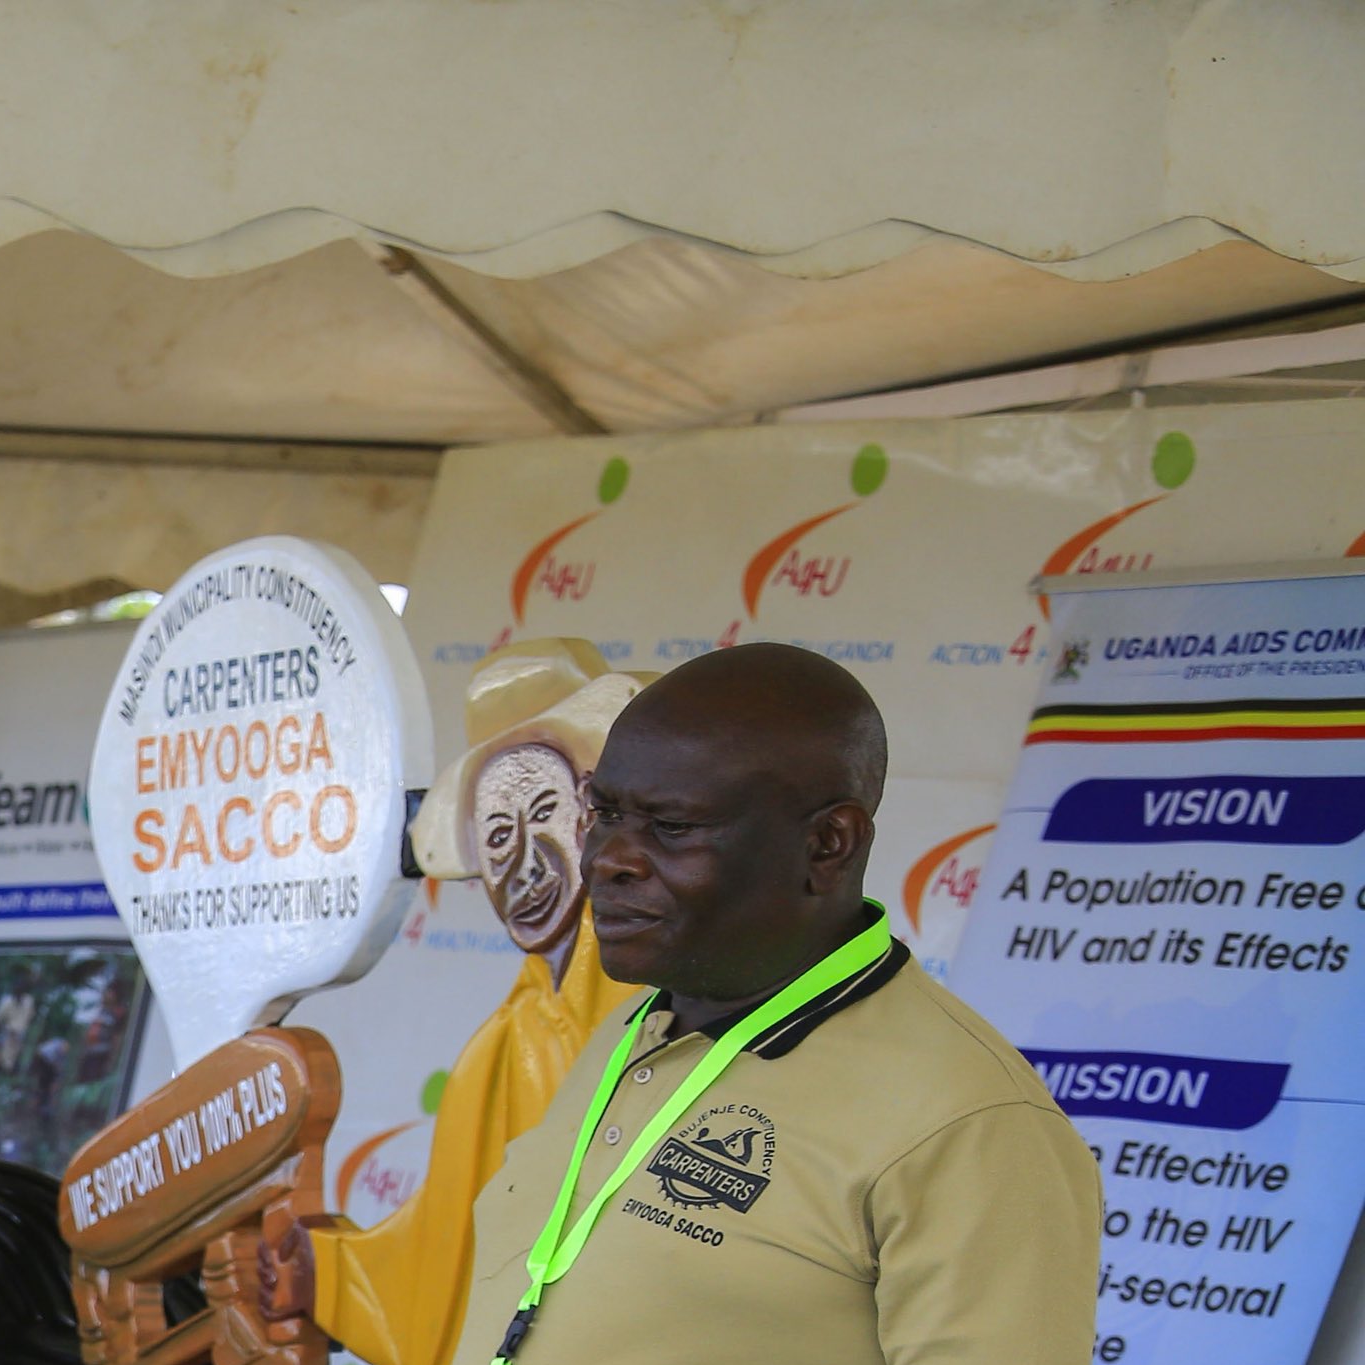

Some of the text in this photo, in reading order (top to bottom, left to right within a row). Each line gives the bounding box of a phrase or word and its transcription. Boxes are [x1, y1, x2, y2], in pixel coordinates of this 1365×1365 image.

[1009, 624, 1037, 664] 4
[1104, 636, 1217, 661] UGANDA
[1222, 630, 1287, 657] AIDS
[163, 644, 320, 718] CARPENTERS
[1184, 663, 1235, 679] OFFICE
[1237, 662, 1257, 678] OF
[1258, 660, 1287, 677] THE
[135, 711, 334, 795] EMYOOGA
[132, 784, 359, 874] SACCO
[1143, 788, 1289, 828] VISION
[133, 887, 192, 936] THANKS
[195, 886, 227, 931] FOR
[229, 878, 331, 928] SUPPORTING
[336, 875, 359, 918] US
[1002, 868, 1029, 901] A
[1042, 868, 1245, 913] Population
[1255, 872, 1343, 912] Free
[1007, 926, 1350, 974] HIV and its Effects
[678, 1104, 736, 1138] BUJENJE
[69, 1174, 98, 1233] WE
[92, 1133, 165, 1218] SUPPORT
[163, 1111, 202, 1176] YOU
[237, 1061, 287, 1133] PLUS
[1112, 1140, 1291, 1193] Effective
[657, 1147, 756, 1202] CARPENTERS
[621, 1198, 725, 1248] EMYOOGA SACCO
[1141, 1206, 1208, 1249] the
[1217, 1215, 1294, 1255] HIV
